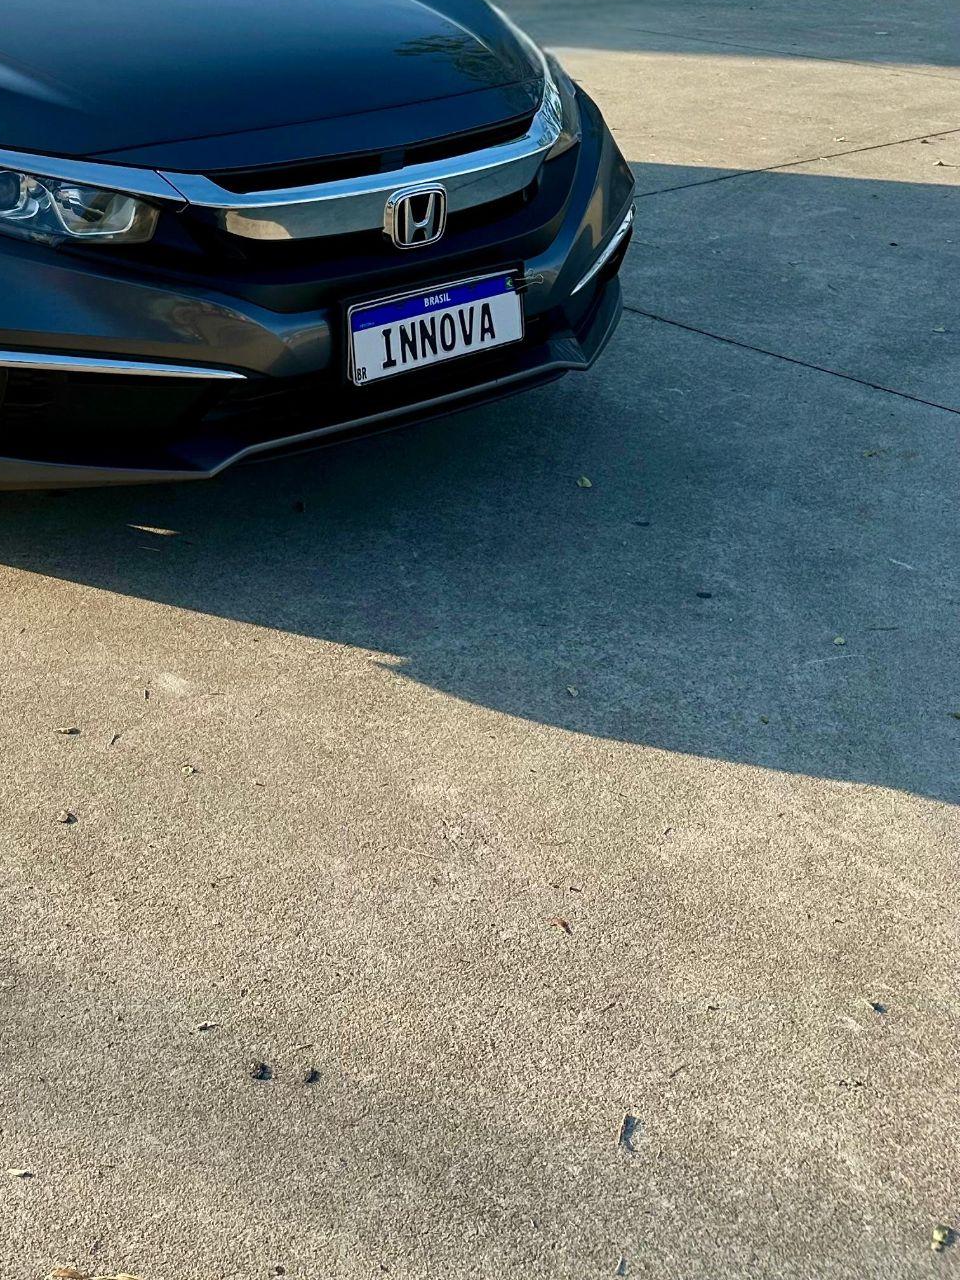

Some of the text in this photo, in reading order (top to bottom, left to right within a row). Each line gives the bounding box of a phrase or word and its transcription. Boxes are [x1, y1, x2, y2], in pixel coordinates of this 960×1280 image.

[424, 292, 451, 307] BRASIL
[381, 302, 496, 369] INNOVA
[356, 367, 367, 381] BR
